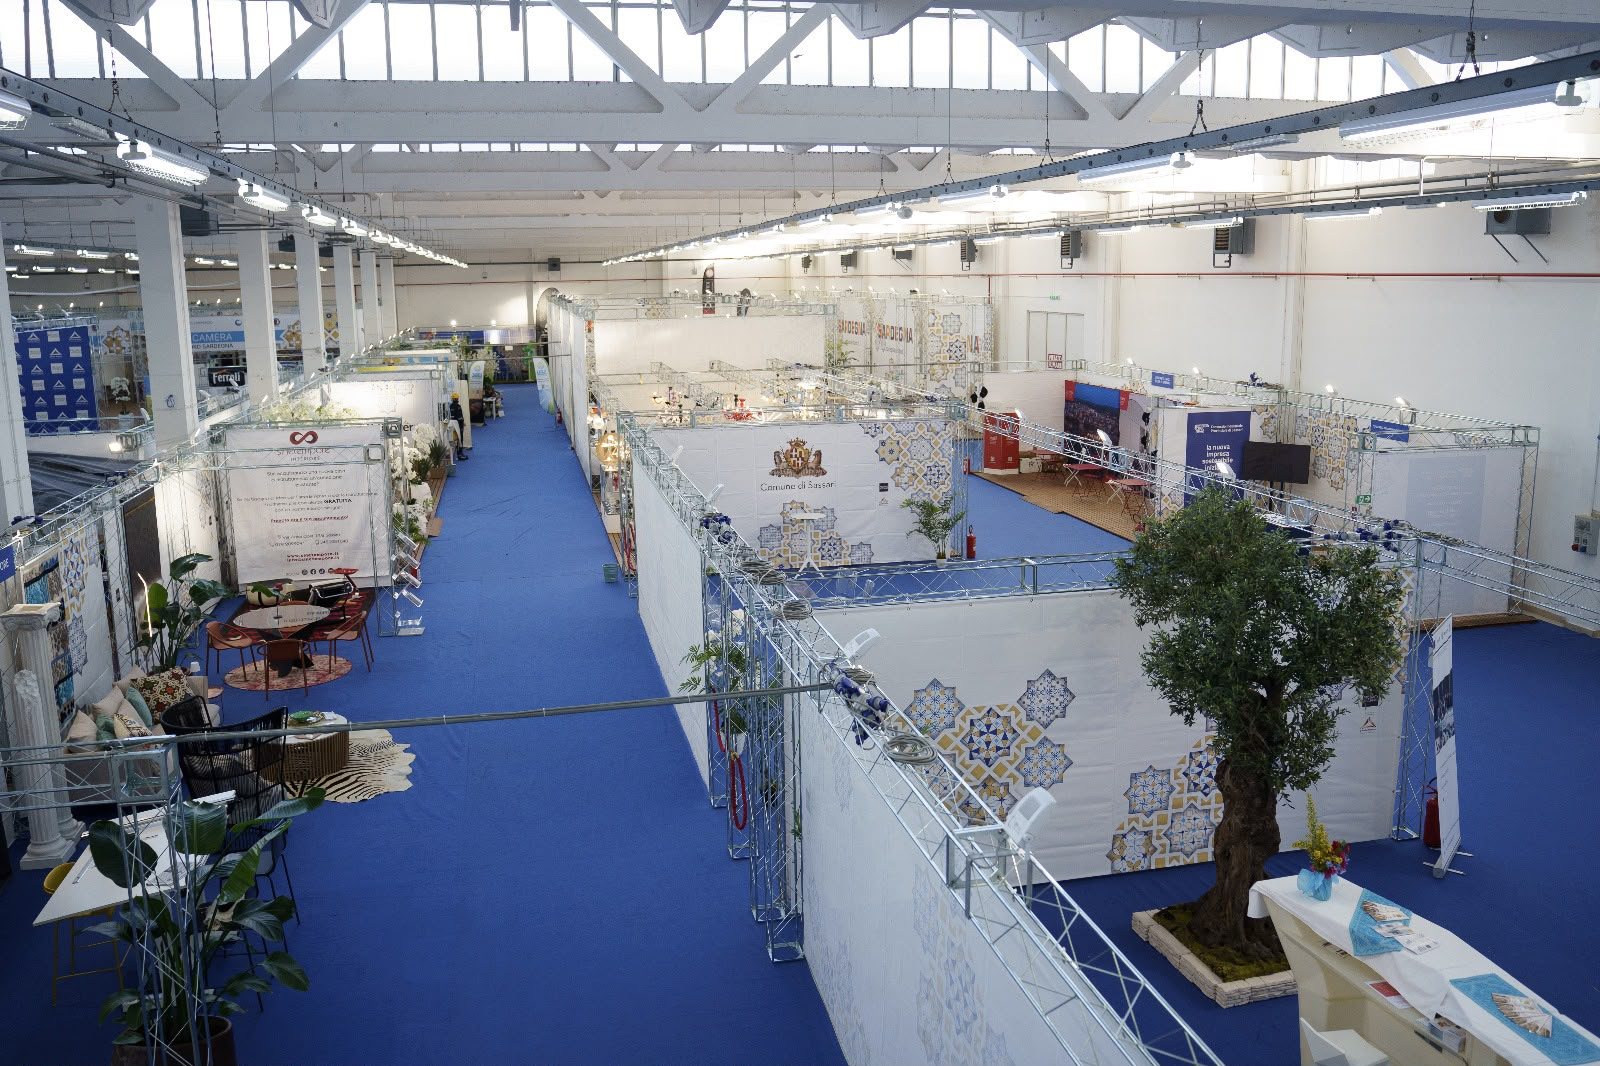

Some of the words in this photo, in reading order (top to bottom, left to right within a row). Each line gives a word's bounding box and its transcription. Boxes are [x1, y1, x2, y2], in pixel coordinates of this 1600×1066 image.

[192, 333, 232, 341] CAMERA
[760, 482, 796, 492] Comune
[797, 480, 806, 490] di
[807, 479, 836, 489] Sassari
